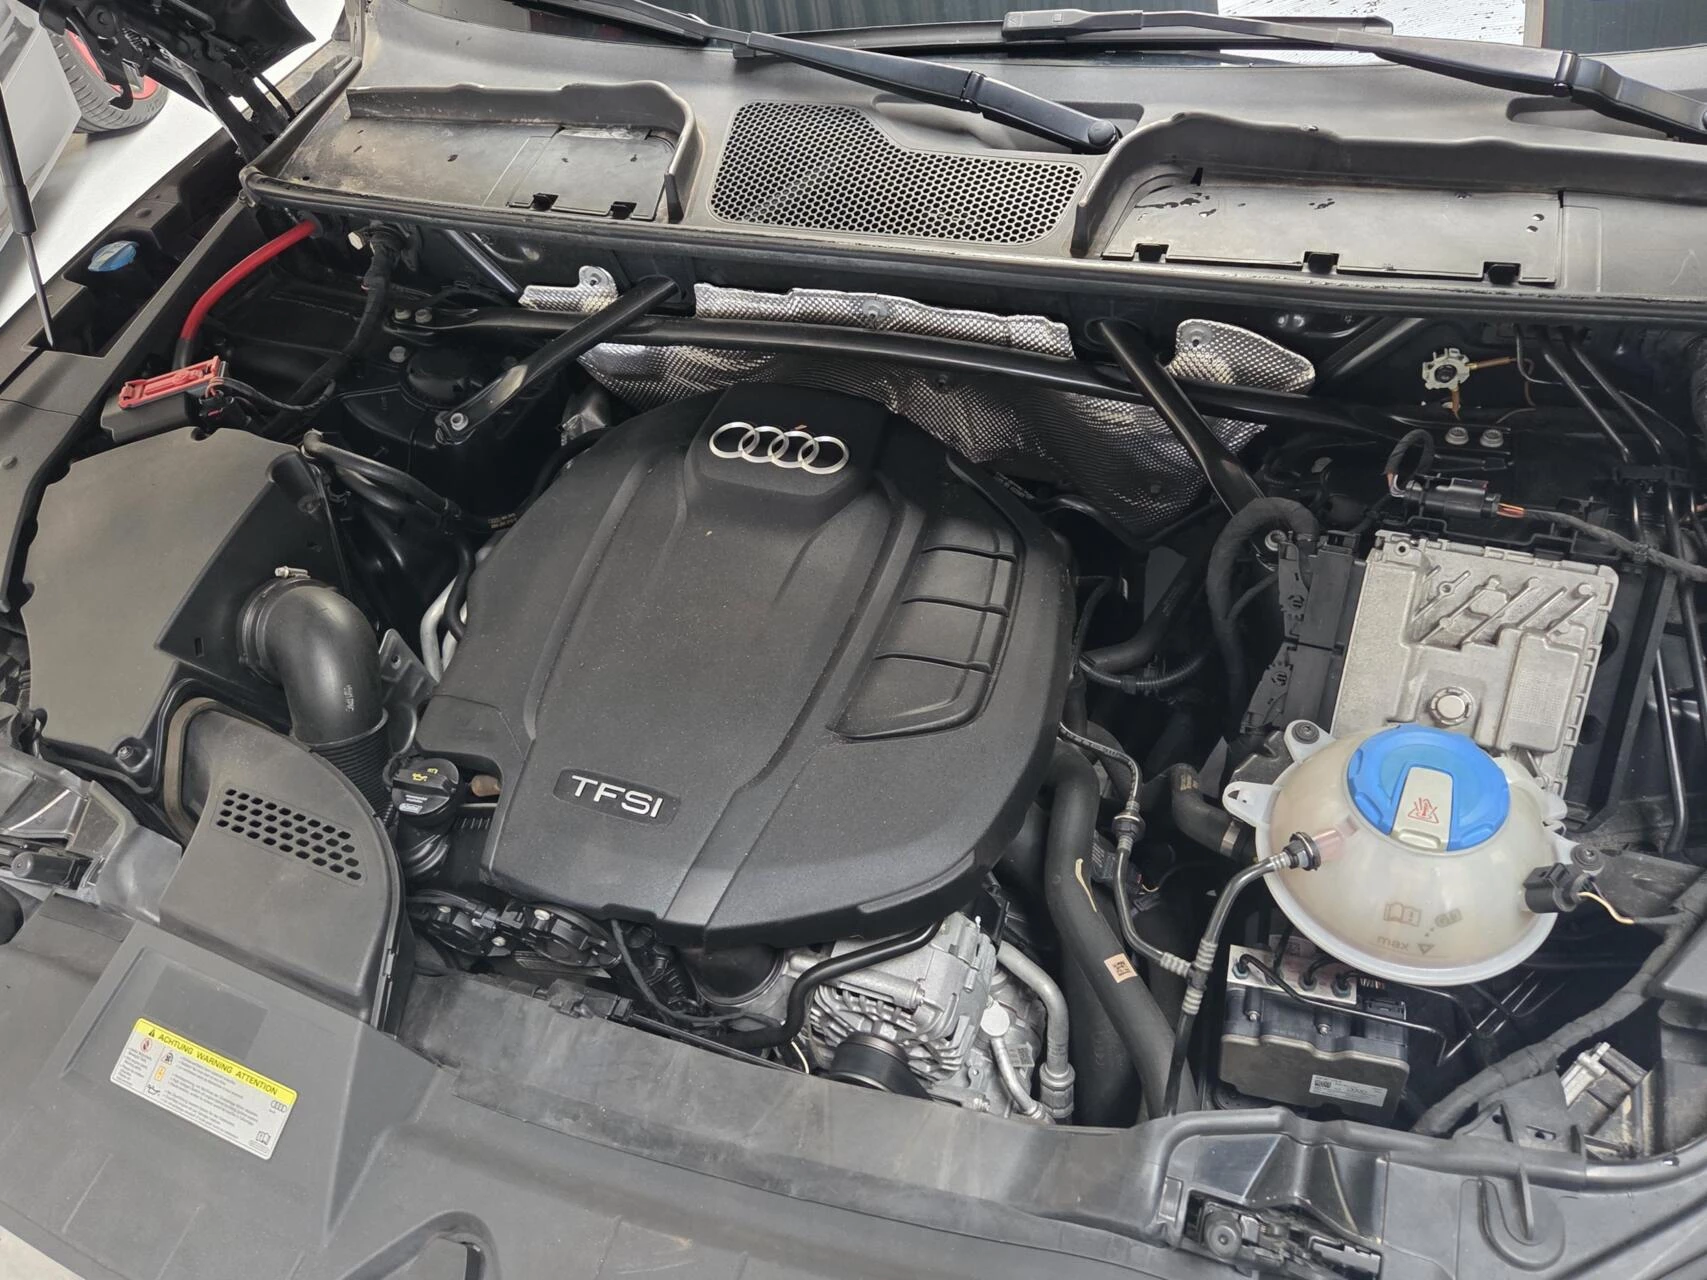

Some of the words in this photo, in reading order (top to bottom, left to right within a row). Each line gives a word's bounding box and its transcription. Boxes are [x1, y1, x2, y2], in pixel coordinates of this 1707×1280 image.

[571, 775, 664, 818] TFSI
[1377, 936, 1409, 951] max
[158, 1031, 194, 1056] ACHTUNG
[196, 1051, 233, 1074] WARNING
[235, 1071, 279, 1095] ATTENTION
